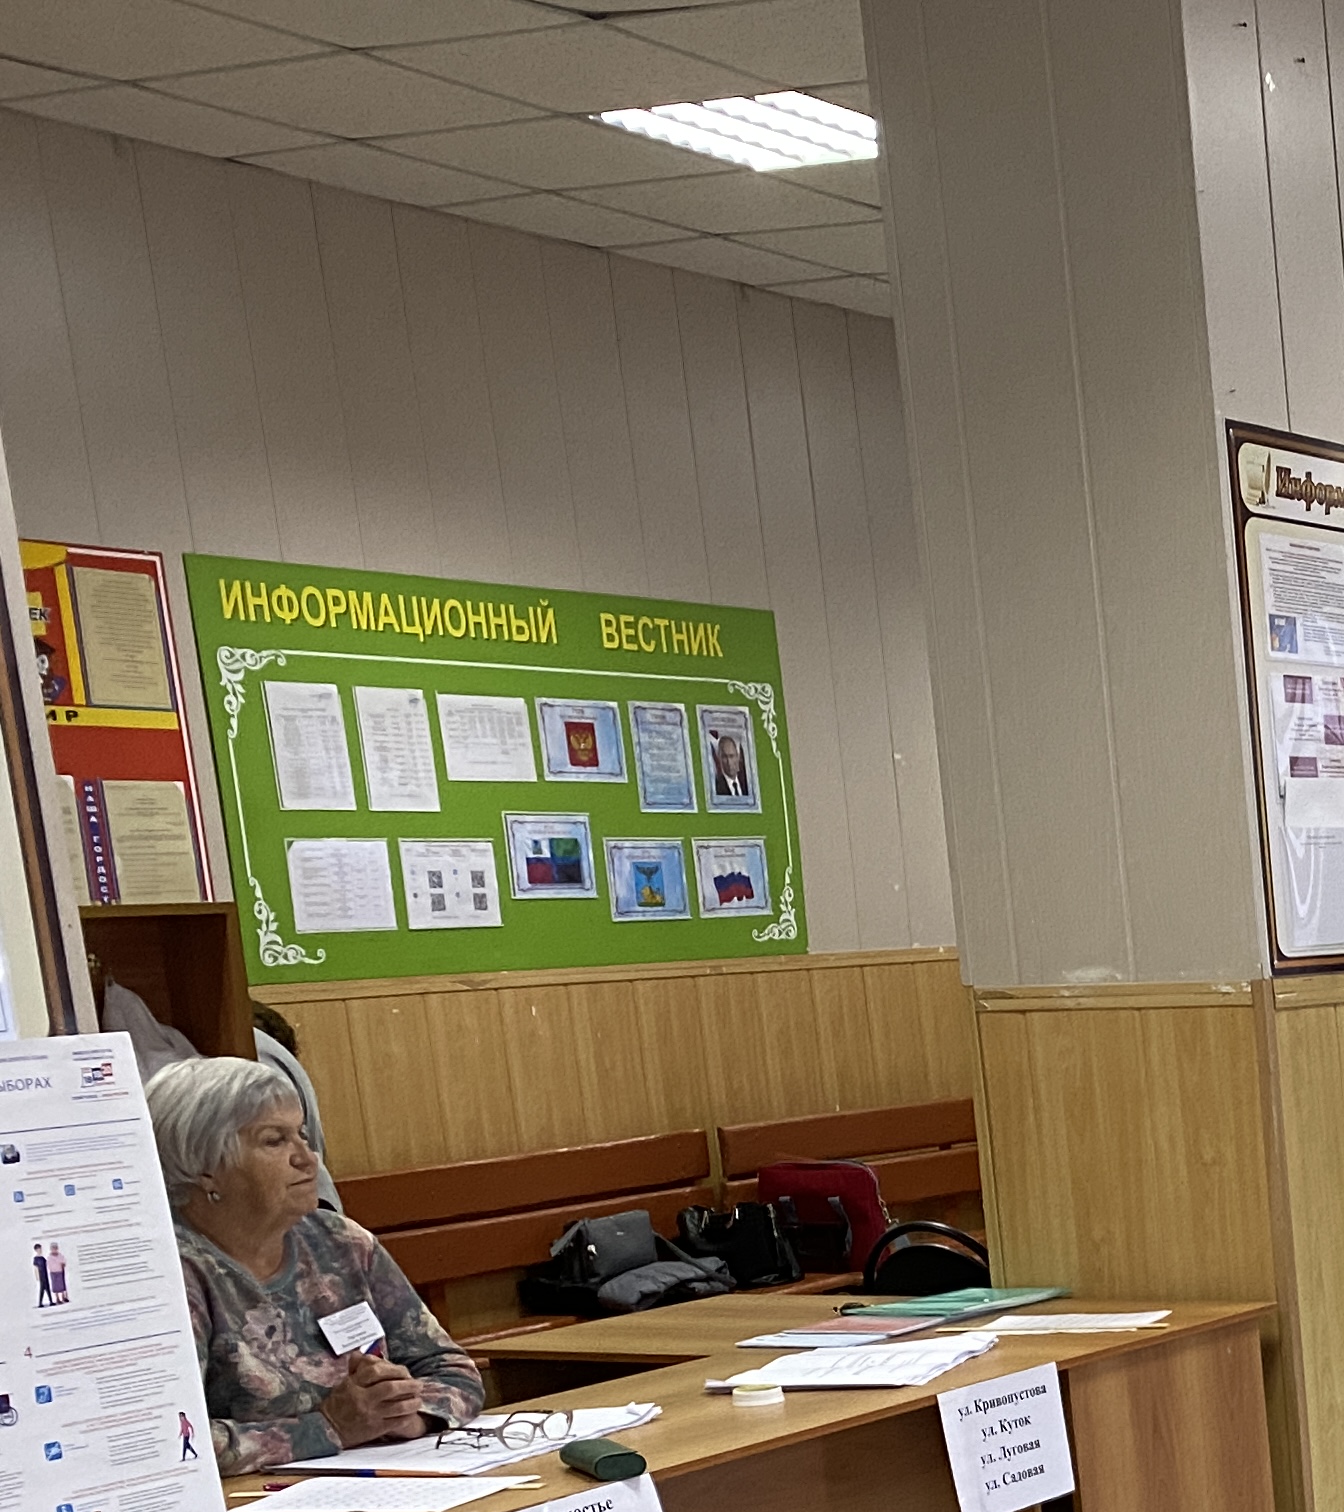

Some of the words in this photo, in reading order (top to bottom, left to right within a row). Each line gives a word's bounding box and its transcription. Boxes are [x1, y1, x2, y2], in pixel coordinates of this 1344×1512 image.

[218, 577, 558, 643] ИНФОРМАЦИОННЫЙ
[600, 612, 724, 657] ВЕСТНИК
[84, 785, 98, 823] НАША
[92, 835, 109, 903] ГОРДОСТ
[24, 1346, 32, 1358] 4
[957, 1407, 973, 1422] ул.
[974, 1384, 1047, 1414] Кривопустова
[981, 1427, 998, 1442] ул.
[1000, 1415, 1032, 1434] Куток
[980, 1454, 996, 1469] ул.
[998, 1439, 1041, 1461] Луговая
[985, 1481, 1001, 1495] ул.
[1002, 1464, 1045, 1485] Садовая
